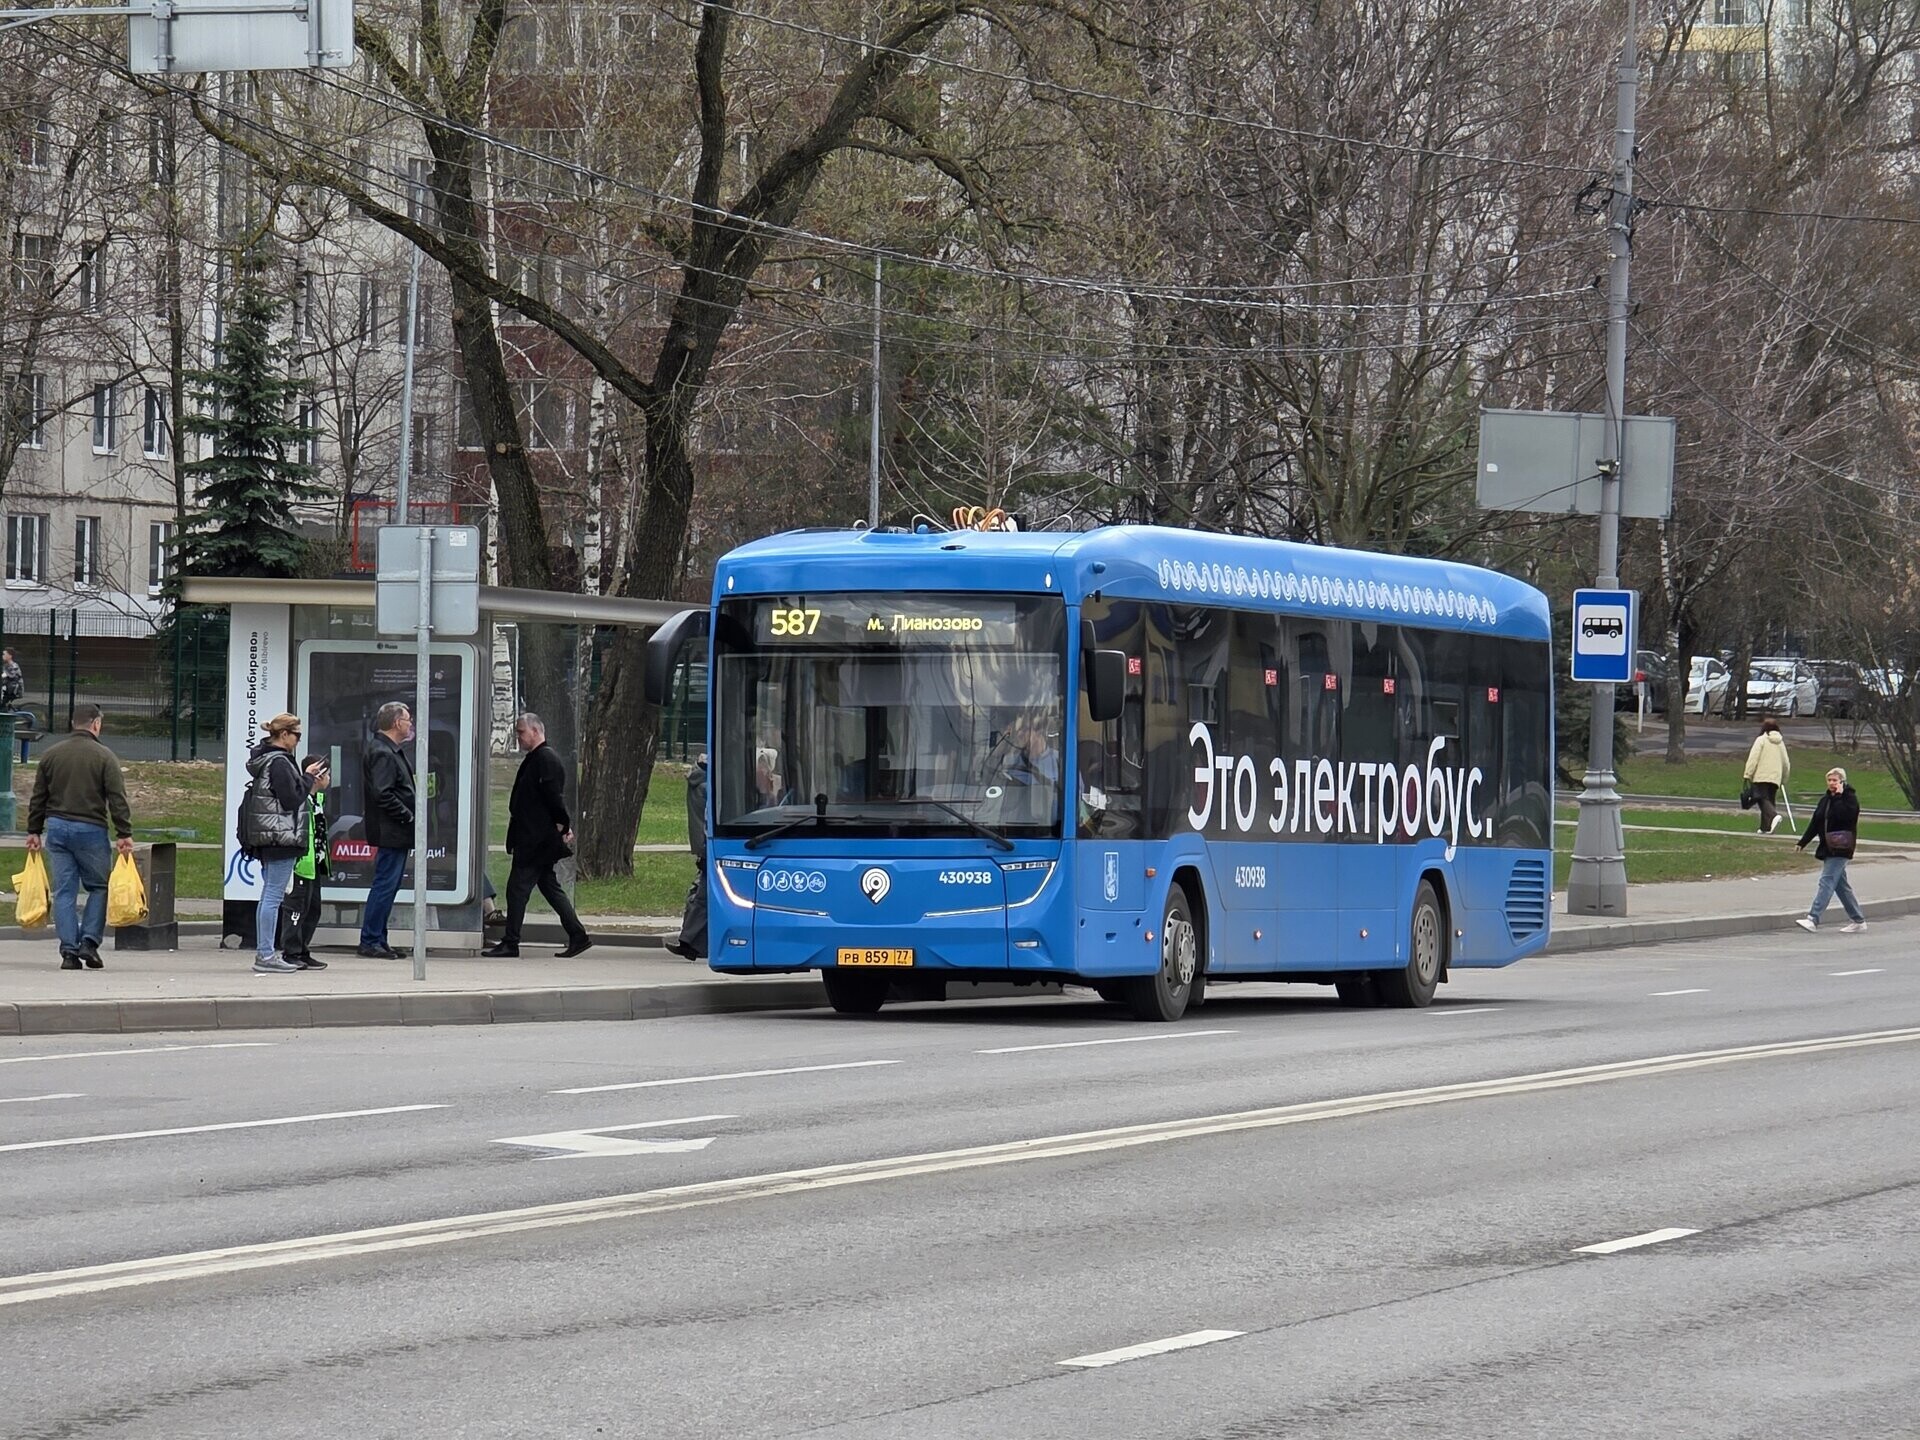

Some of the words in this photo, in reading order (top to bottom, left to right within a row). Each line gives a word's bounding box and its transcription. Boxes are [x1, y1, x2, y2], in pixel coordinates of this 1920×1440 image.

[770, 609, 821, 636] 587
[867, 617, 885, 632] м.
[891, 614, 983, 632] Лианозово
[248, 632, 259, 706] «Бибирево»
[245, 709, 258, 750] Метро
[1187, 721, 1257, 832] Это
[1268, 736, 1493, 863] электробус.
[336, 844, 372, 857] МЦД
[409, 846, 446, 859] лди!
[939, 871, 992, 884] 430938
[1235, 866, 1266, 888] 430938
[865, 951, 889, 964] 859
[896, 950, 909, 961] 77
